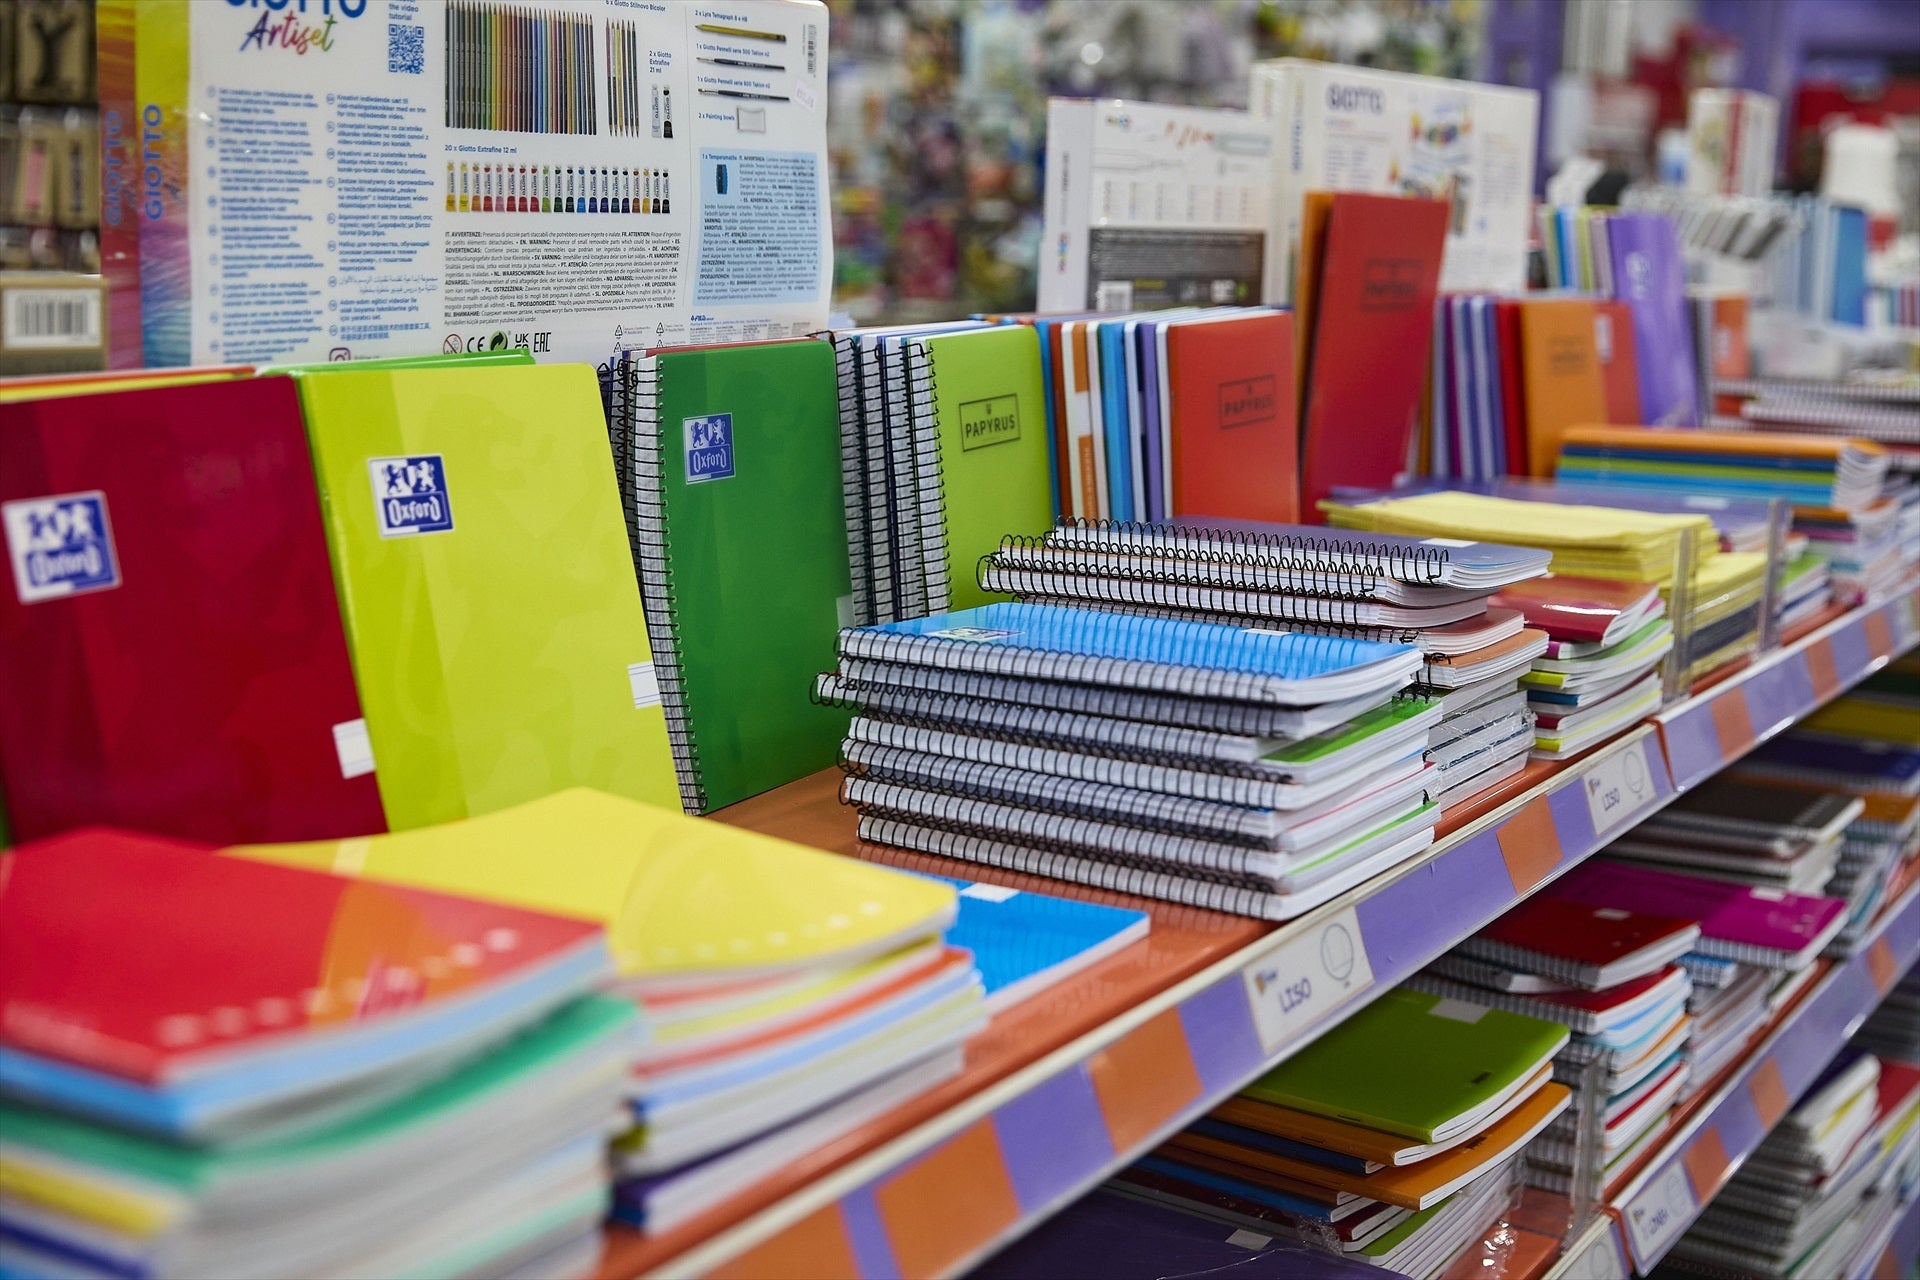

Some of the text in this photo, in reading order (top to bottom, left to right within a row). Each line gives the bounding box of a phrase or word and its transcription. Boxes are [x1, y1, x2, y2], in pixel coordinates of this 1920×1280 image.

[238, 10, 338, 55] Artiset
[143, 104, 163, 220] GIOTTO
[515, 333, 529, 343] UK
[534, 332, 551, 352] EAC
[966, 414, 1015, 438] PAPYRUS
[693, 448, 727, 473] Oxford
[388, 496, 441, 526] Oxford
[1279, 977, 1312, 1014] LISO
